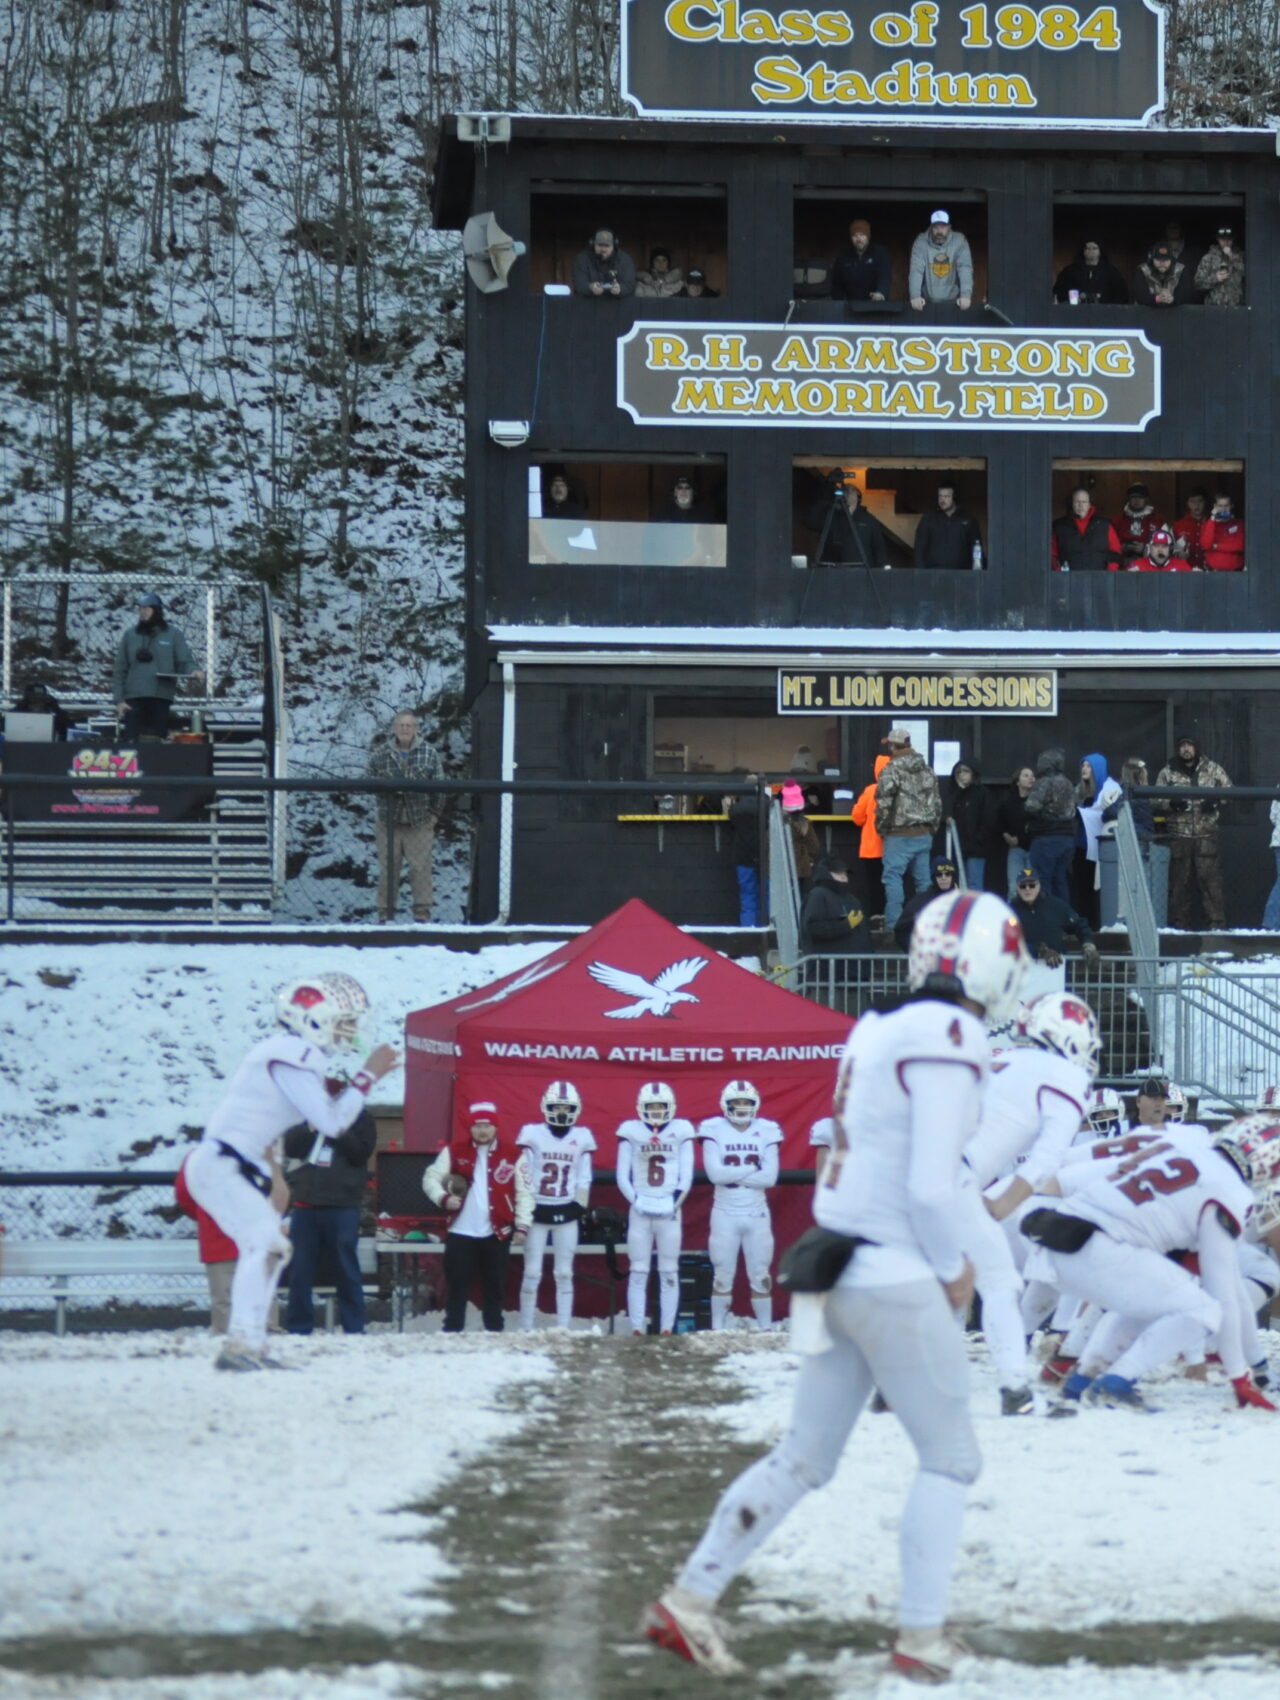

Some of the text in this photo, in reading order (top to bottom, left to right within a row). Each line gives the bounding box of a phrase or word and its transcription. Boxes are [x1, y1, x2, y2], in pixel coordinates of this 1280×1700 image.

[666, 0, 1121, 51] Class of 1984
[752, 55, 1037, 107] Stadium
[647, 333, 1135, 377] R.H. ARMSTRONG
[673, 377, 1108, 420] MEMORIAL FIELD
[783, 676, 1052, 707] MT. LION CONCESSIONS
[79, 749, 138, 770] 94.7
[484, 1041, 846, 1062] WAHAMA ATHLETIC TRAINING
[538, 1163, 570, 1198] 21
[647, 1154, 666, 1188] 6
